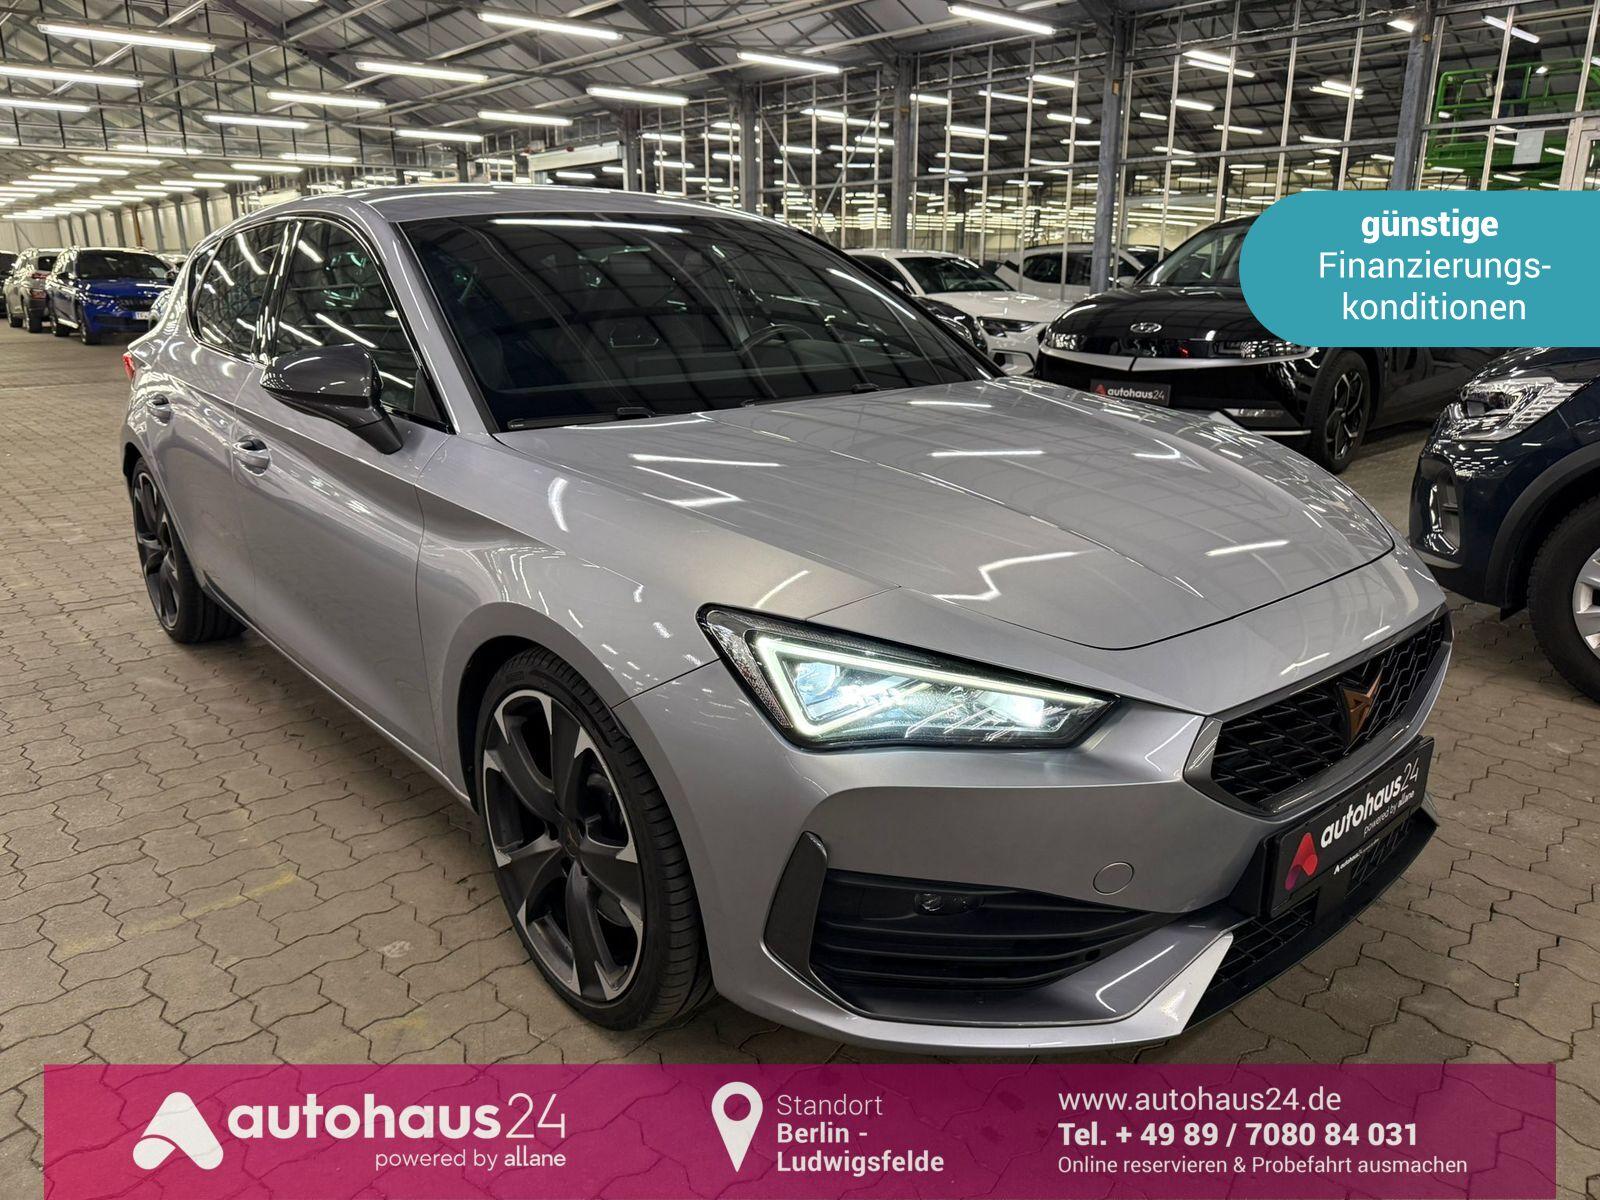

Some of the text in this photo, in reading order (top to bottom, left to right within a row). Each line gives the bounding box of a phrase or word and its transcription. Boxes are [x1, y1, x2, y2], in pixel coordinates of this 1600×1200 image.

[1107, 387, 1165, 400] autohaus24
[1320, 757, 1419, 848] autohaus24
[1363, 805, 1389, 838] powered
[1389, 803, 1397, 815] by
